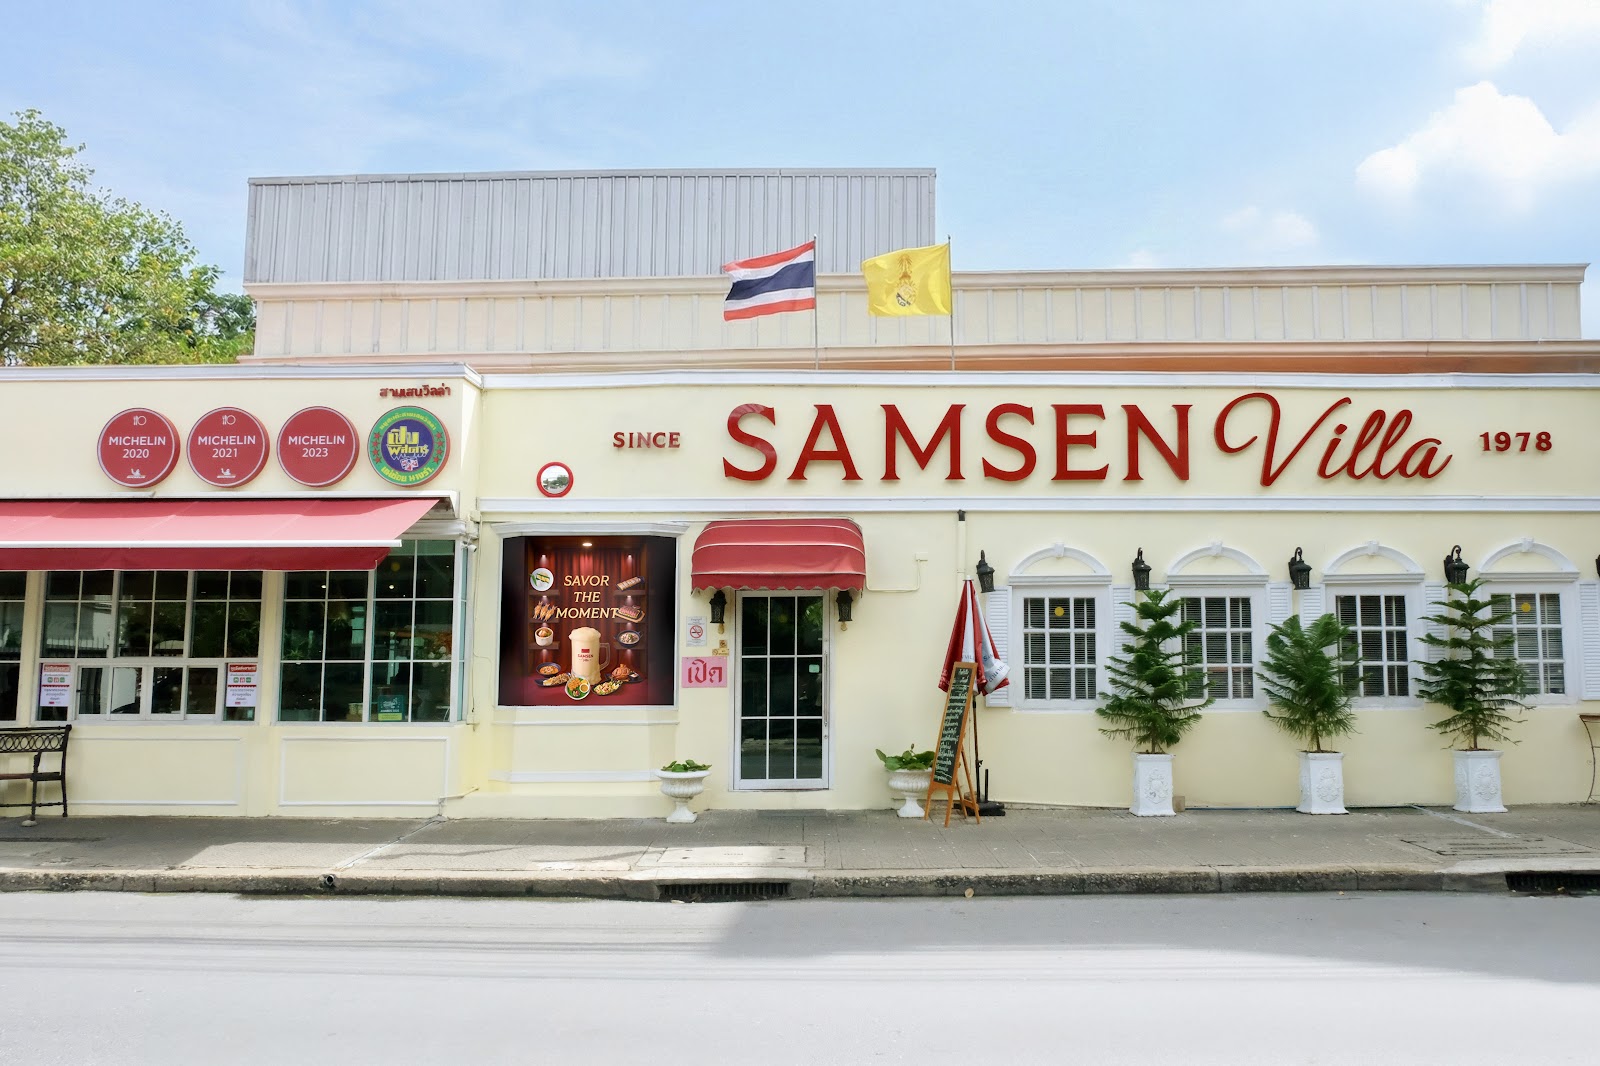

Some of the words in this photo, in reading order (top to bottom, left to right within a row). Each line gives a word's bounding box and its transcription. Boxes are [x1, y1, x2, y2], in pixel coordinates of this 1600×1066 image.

[380, 383, 450, 397] สามเสนวิลล่า
[108, 436, 166, 447] MICHELIN
[197, 435, 256, 446] MICHELIN
[288, 435, 345, 446] MICHELIN
[613, 431, 681, 449] SINCE
[722, 403, 1191, 483] SAMSEN
[1214, 391, 1453, 487] Villa
[1480, 430, 1553, 452] 1978
[122, 448, 150, 459] 2020
[212, 447, 238, 458] 2021
[302, 447, 329, 458] 2023
[563, 575, 610, 587] SAVOR
[573, 591, 601, 603] THE
[555, 607, 617, 619] MOMENT
[687, 658, 723, 684] เปิด
